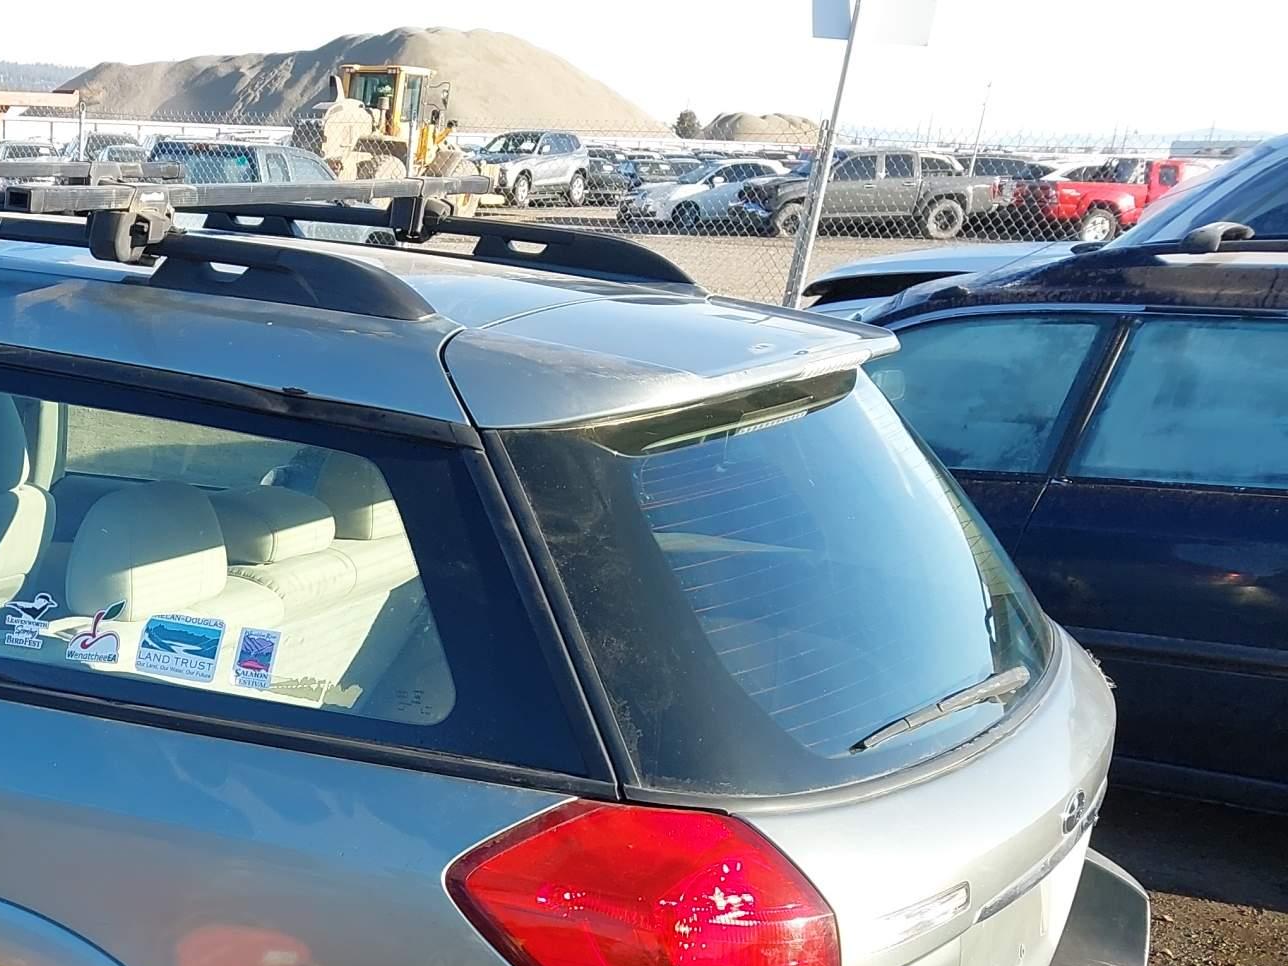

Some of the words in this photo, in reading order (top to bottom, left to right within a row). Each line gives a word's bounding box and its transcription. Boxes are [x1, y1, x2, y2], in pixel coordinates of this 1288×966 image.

[150, 614, 225, 629] ELAN-DOUGLAS
[138, 650, 171, 664] LAND
[174, 657, 213, 672] TRUST
[235, 669, 268, 681] SALMON
